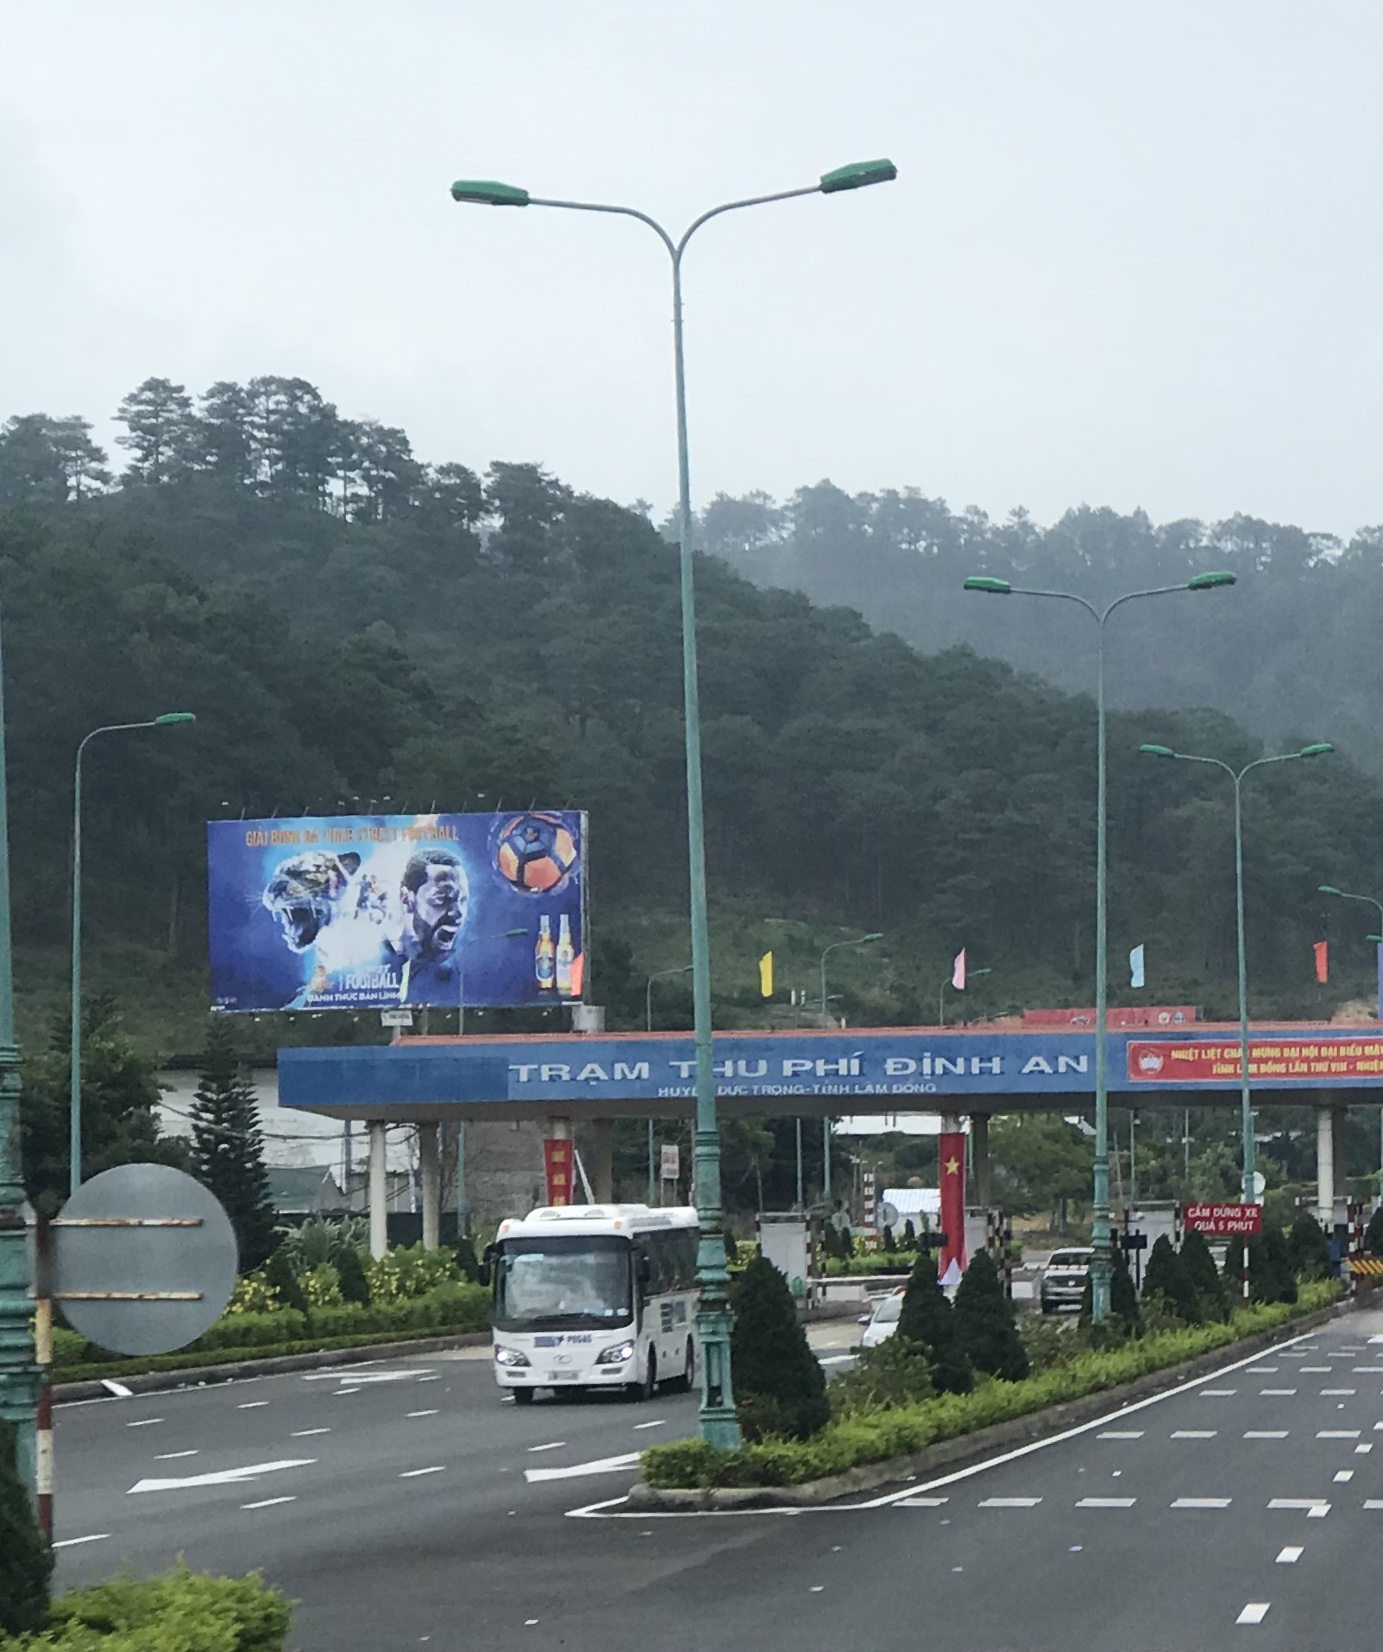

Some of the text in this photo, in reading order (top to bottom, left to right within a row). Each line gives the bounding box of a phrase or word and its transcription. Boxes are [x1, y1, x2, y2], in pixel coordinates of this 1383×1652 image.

[508, 1051, 1088, 1085] TRẠM THU PHÍ ĐỊNH AN
[1245, 1207, 1258, 1218] XE
